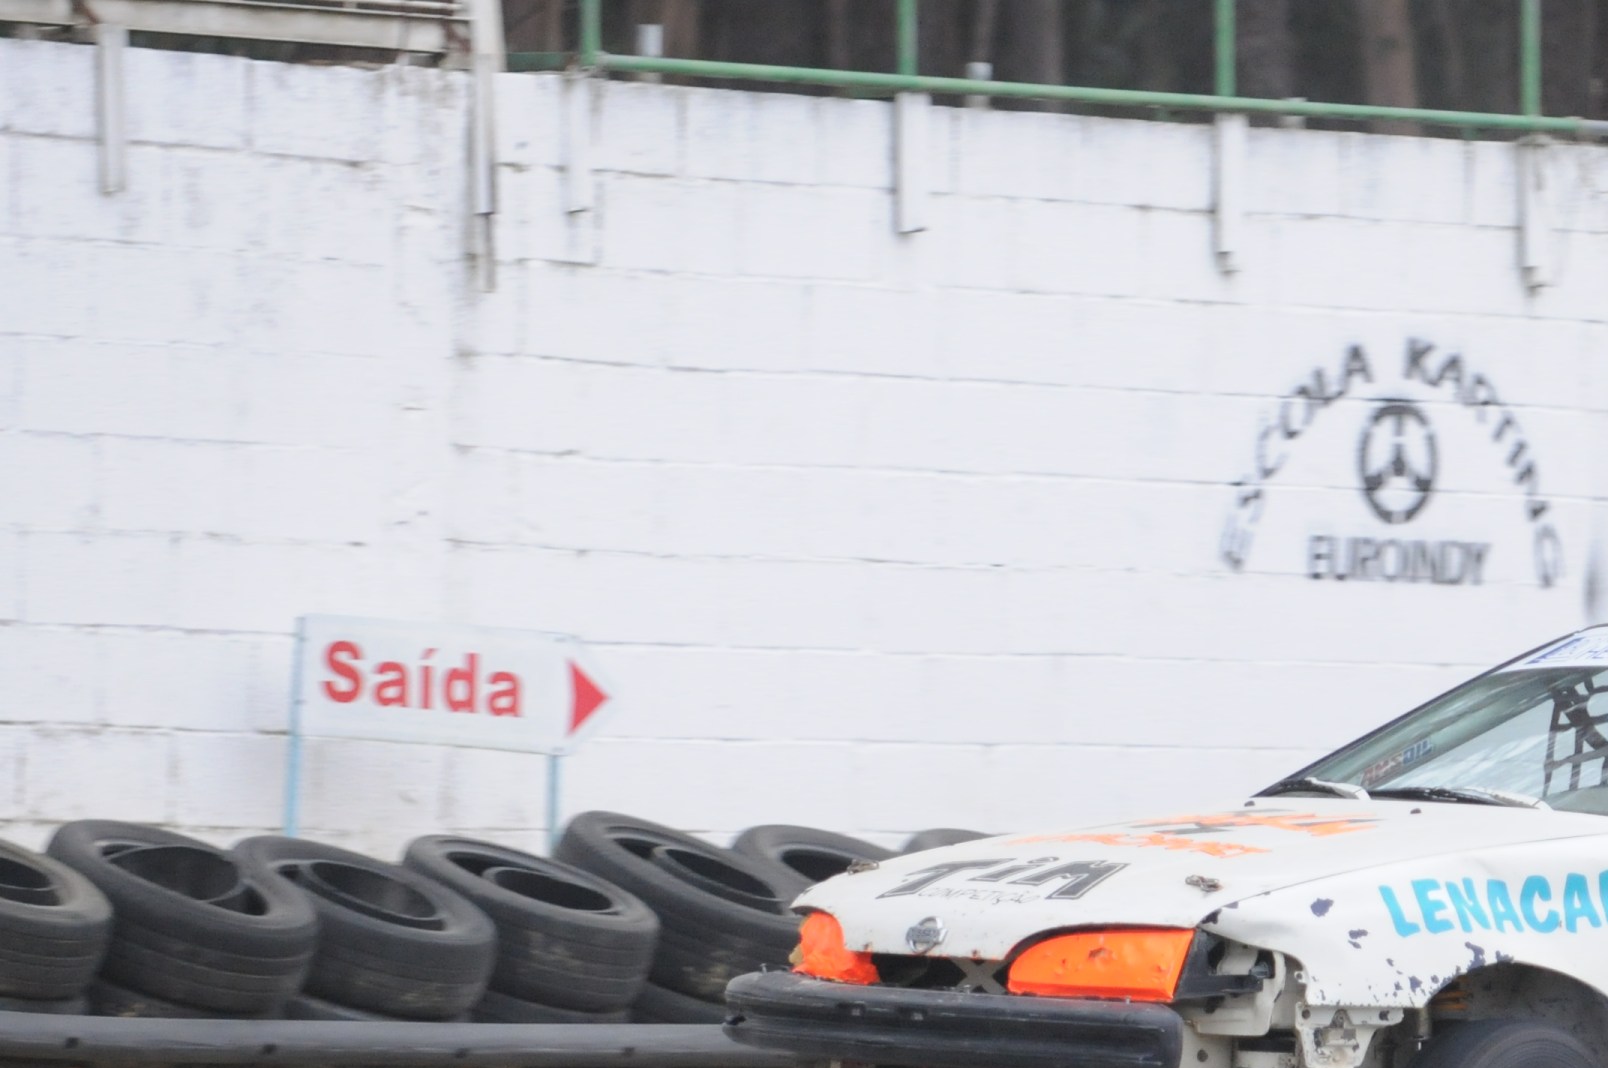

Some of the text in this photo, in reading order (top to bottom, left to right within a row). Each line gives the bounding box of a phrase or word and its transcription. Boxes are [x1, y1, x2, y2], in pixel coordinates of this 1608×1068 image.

[1219, 344, 1375, 574] ESCOLA
[1307, 534, 1492, 586] EUROINDY
[320, 640, 524, 718] Saída
